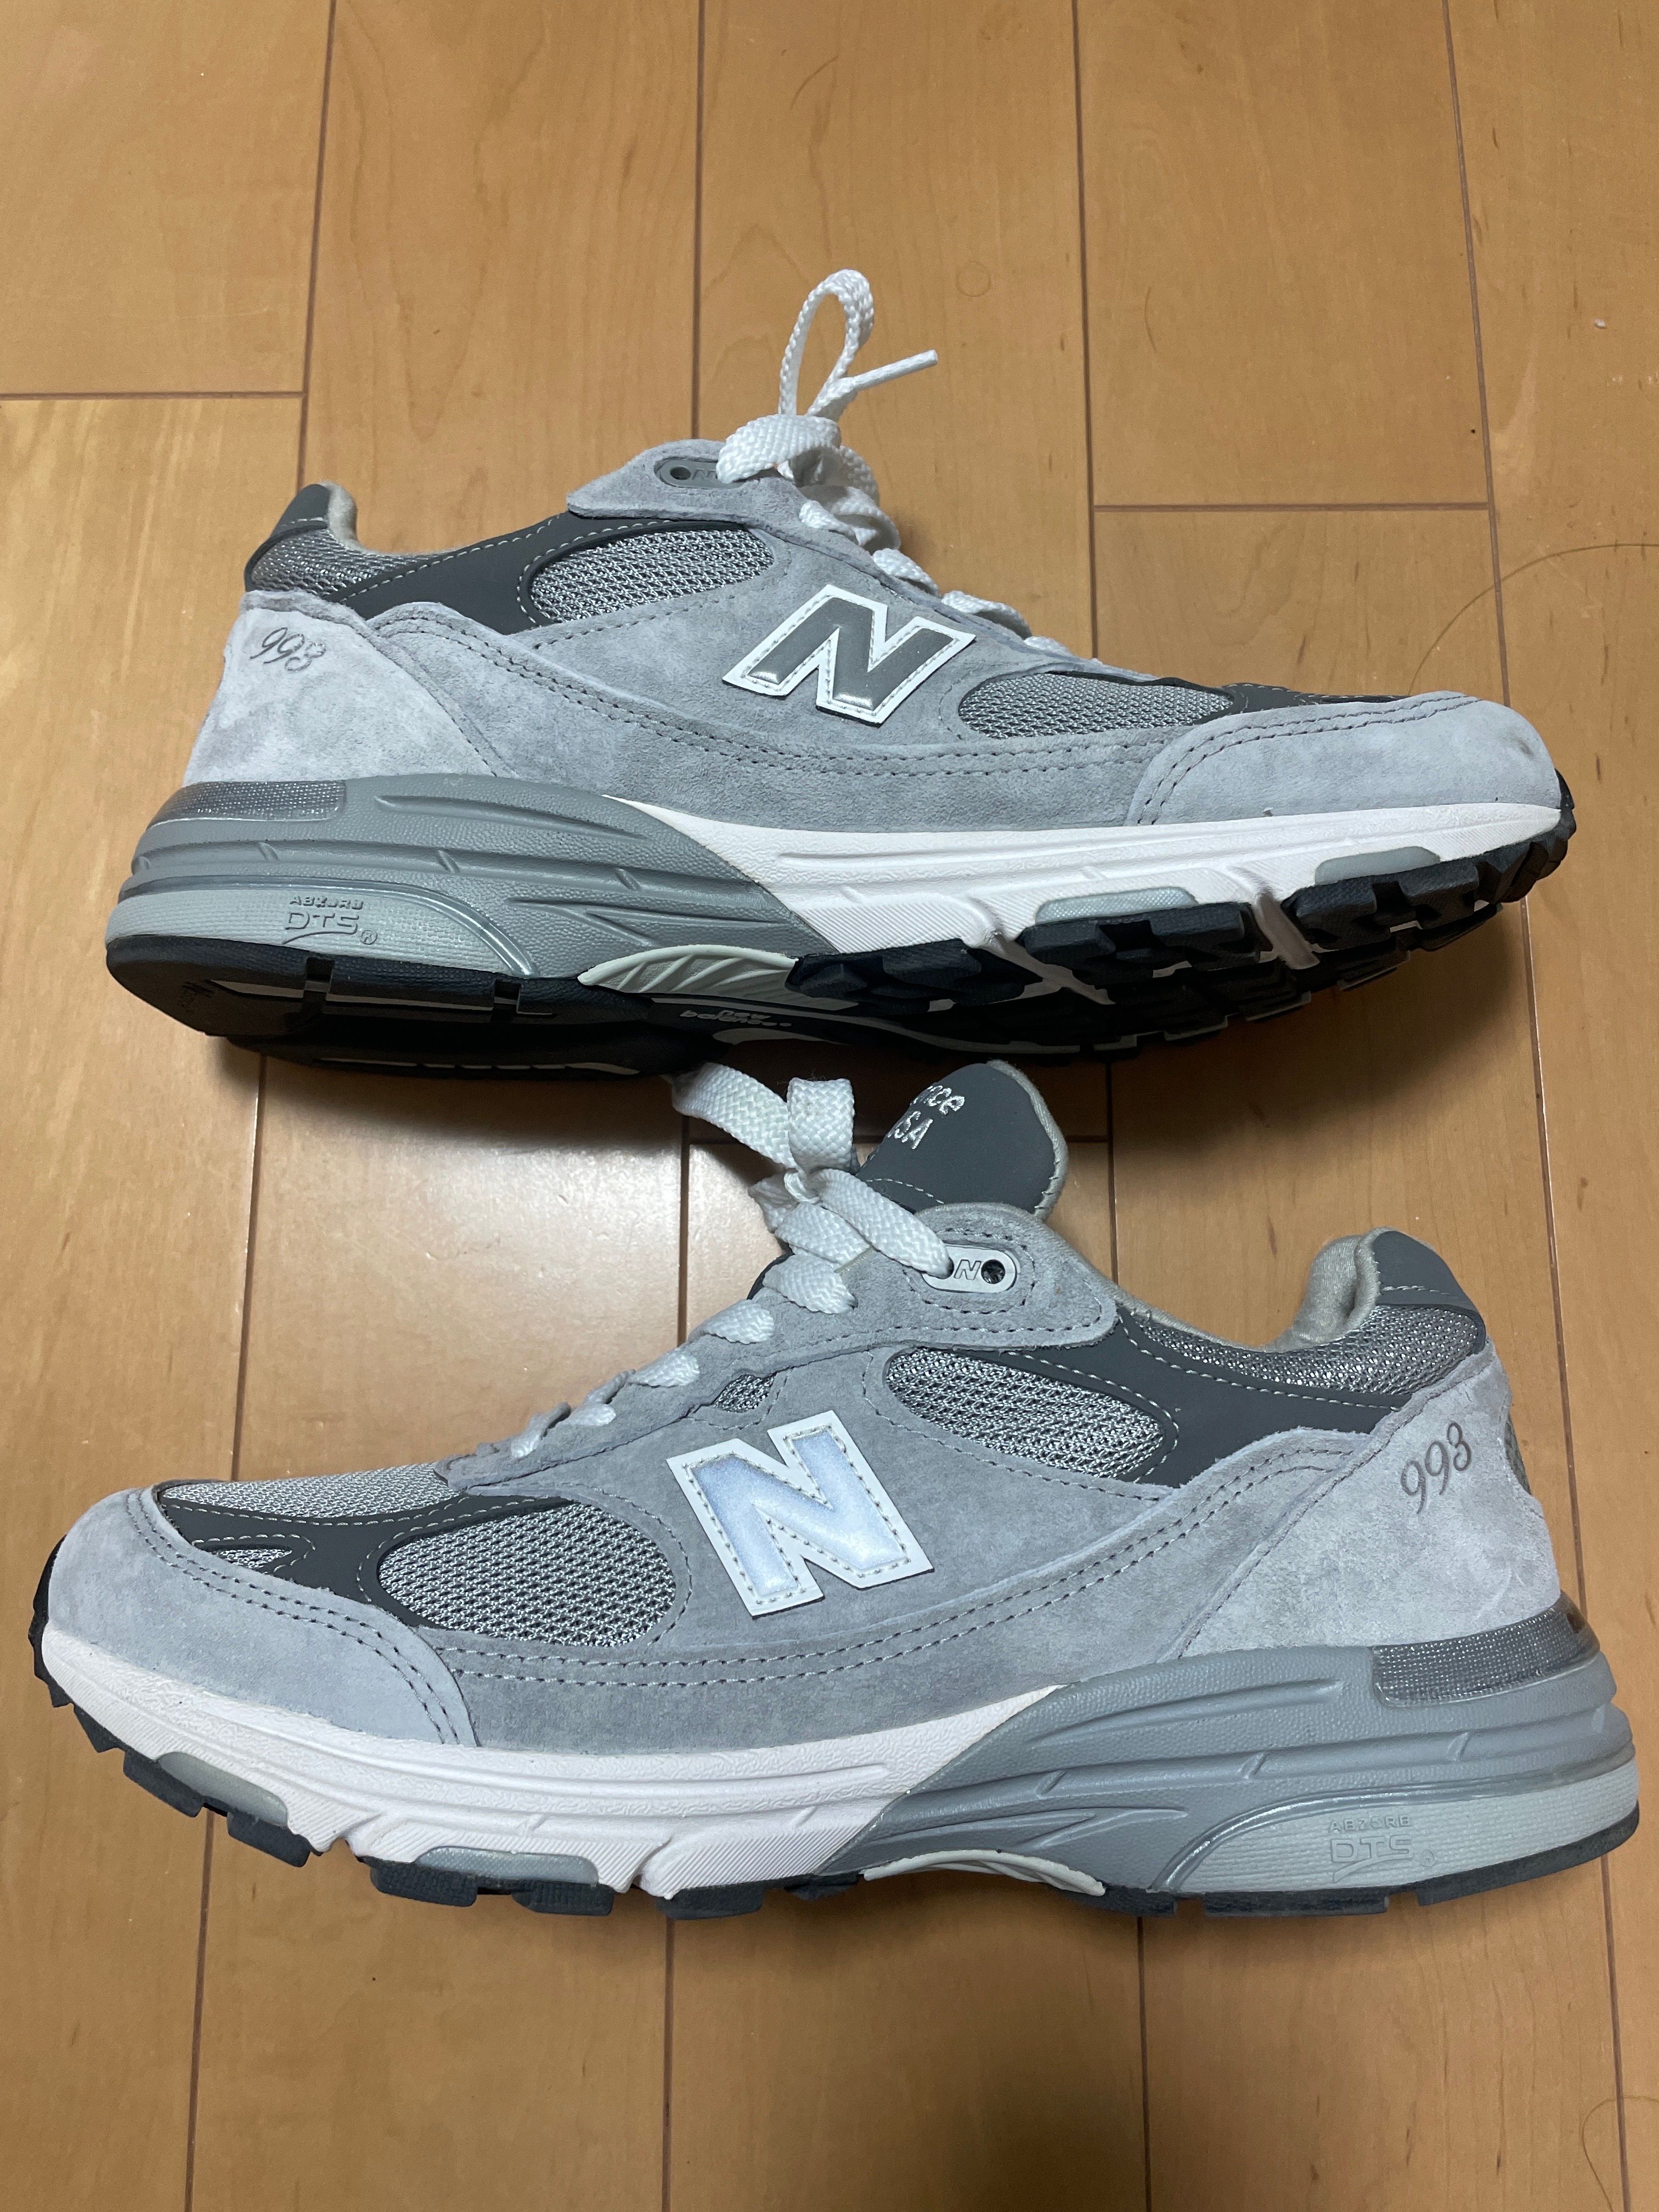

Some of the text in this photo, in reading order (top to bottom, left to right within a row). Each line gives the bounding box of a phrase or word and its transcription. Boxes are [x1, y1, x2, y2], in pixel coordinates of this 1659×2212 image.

[249, 627, 326, 672] 993
[723, 584, 976, 726] N
[283, 912, 360, 938] DTS
[1400, 1422, 1471, 1514] 993
[666, 1409, 935, 1619] N
[1328, 1816, 1412, 1833] ABZORB
[1330, 1833, 1415, 1872] DTS
